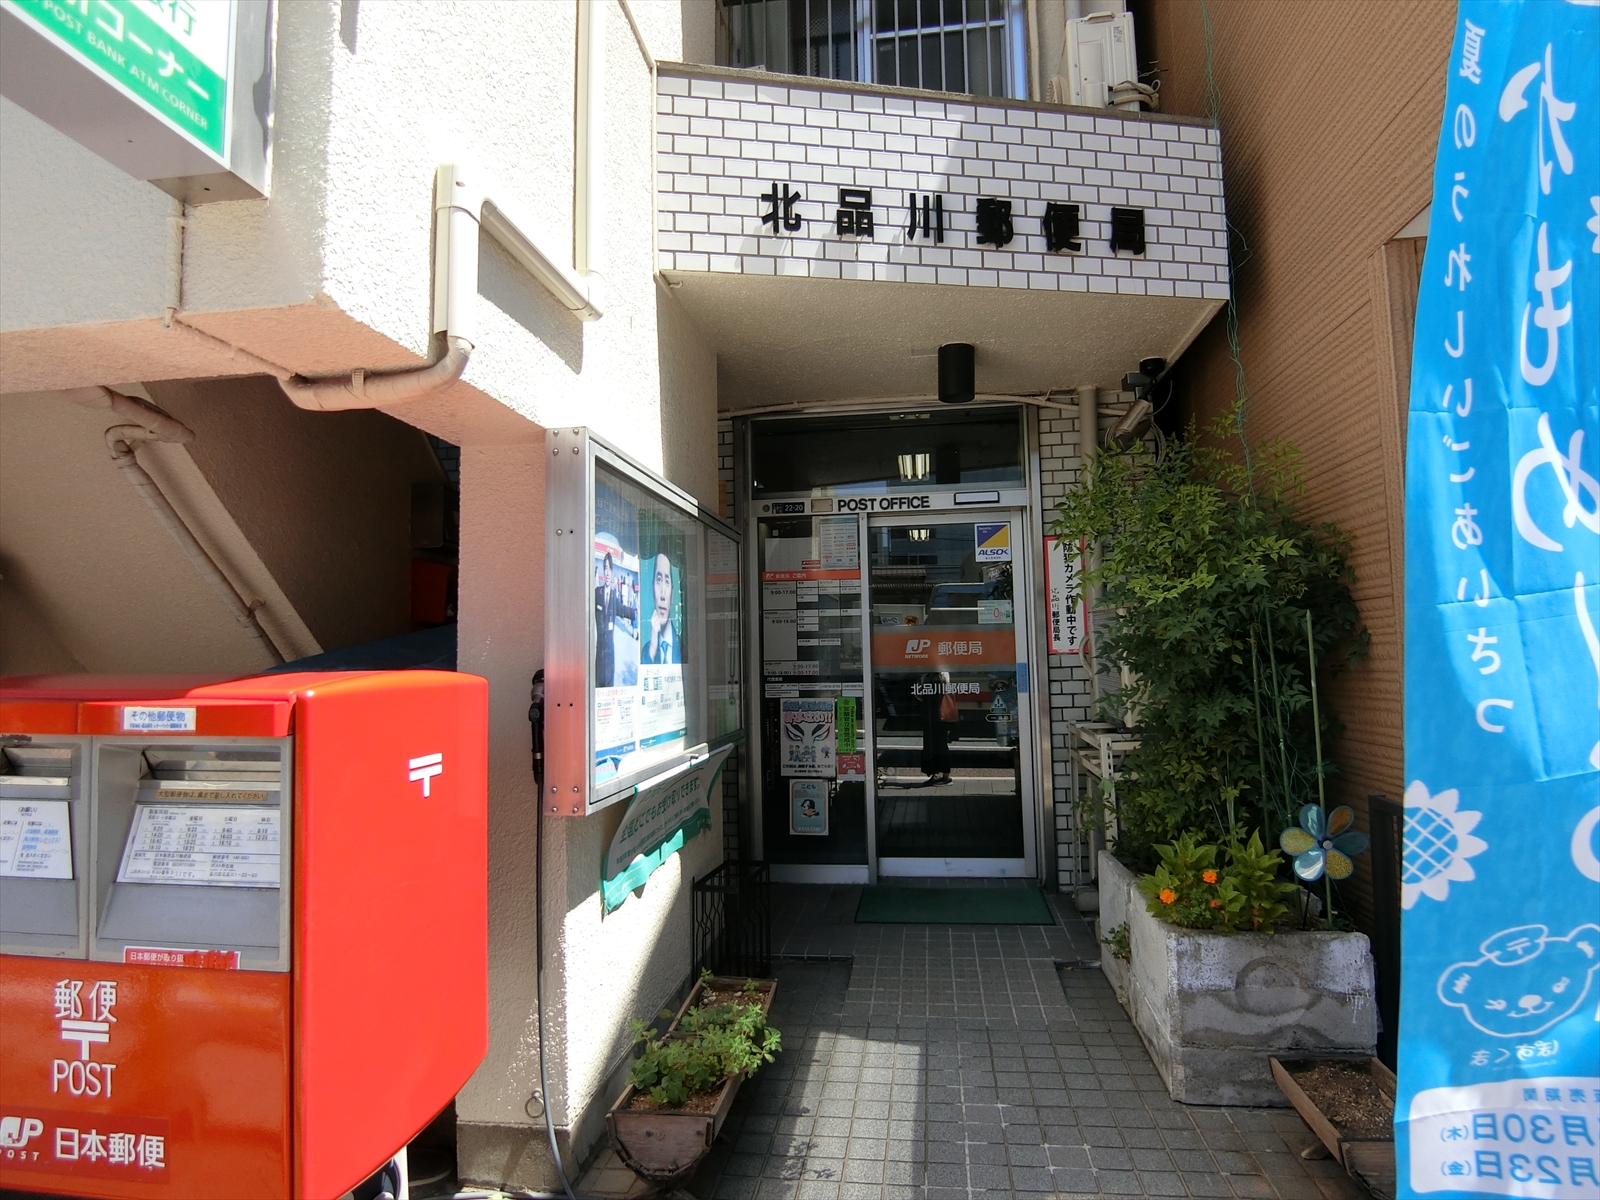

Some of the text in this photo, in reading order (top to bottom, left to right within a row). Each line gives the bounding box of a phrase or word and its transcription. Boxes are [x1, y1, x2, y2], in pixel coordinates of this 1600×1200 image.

[43, 0, 209, 131] POST BANK ATM CORNER
[761, 181, 1147, 255] 北品川郵便局
[838, 495, 931, 512] POST OFFICE
[978, 548, 1009, 556] ALSOK
[905, 639, 983, 656] JP 郵便局
[910, 682, 980, 696] 北品川郵便局
[130, 711, 186, 723] その他郵便物
[54, 978, 118, 1022] 郵便
[53, 1059, 117, 1098] POST
[0, 1148, 40, 1161] OST
[55, 1127, 166, 1169] 日本郵便
